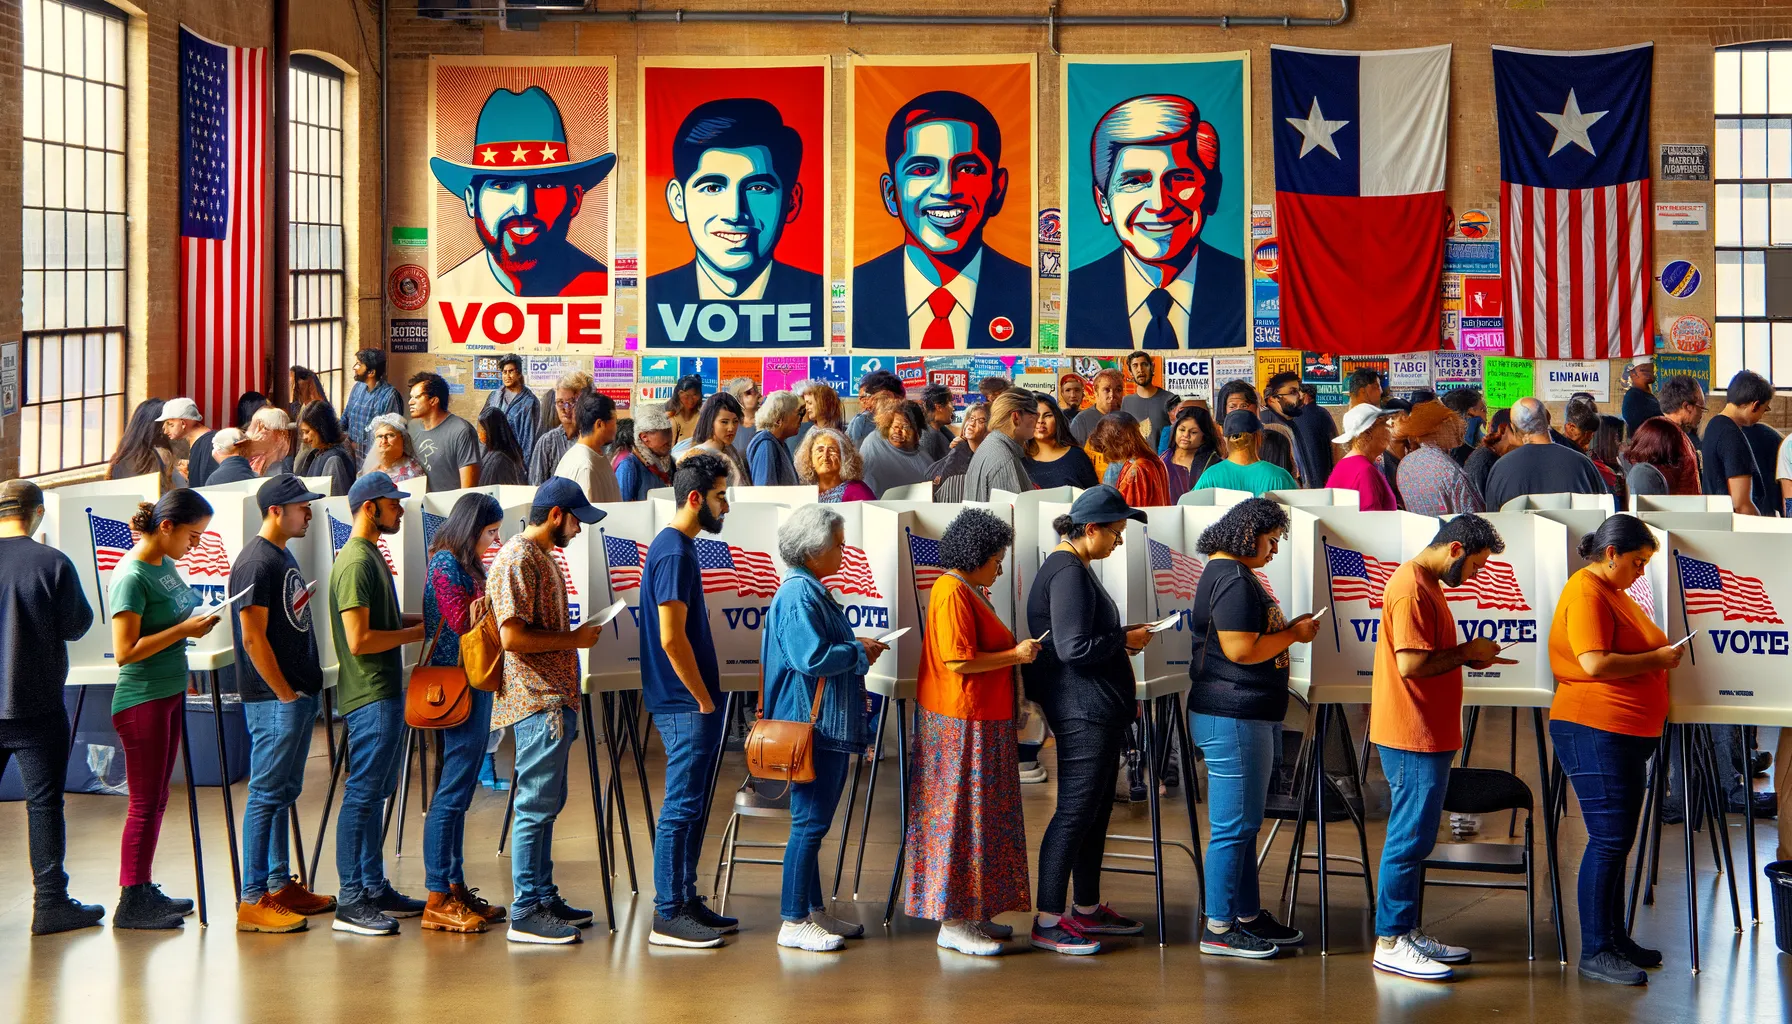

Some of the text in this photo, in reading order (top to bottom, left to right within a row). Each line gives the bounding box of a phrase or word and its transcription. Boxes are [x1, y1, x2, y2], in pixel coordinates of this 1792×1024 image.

[438, 301, 602, 344] VOTE
[657, 303, 812, 342] VOTE
[838, 604, 889, 629] OTE
[1458, 619, 1537, 643] VOTE
[1708, 630, 1789, 655] VOTE
